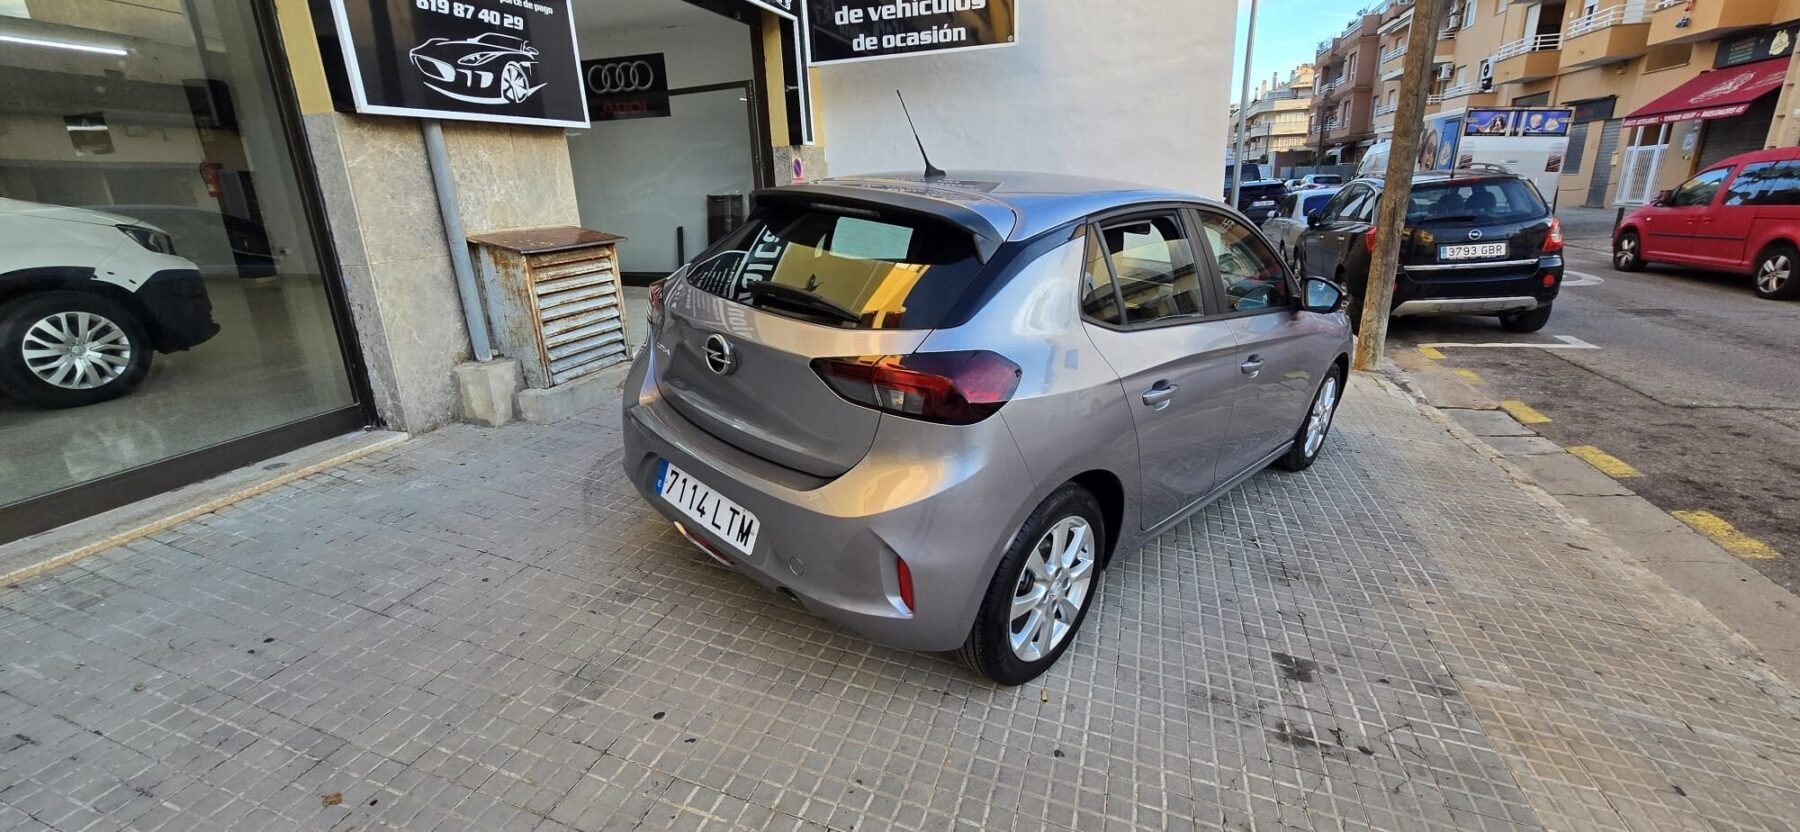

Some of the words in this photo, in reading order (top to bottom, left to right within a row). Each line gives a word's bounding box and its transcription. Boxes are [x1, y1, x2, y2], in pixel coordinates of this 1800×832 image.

[416, 0, 449, 14] 619
[453, 2, 475, 19] 87
[478, 9, 500, 25] 40
[503, 14, 524, 31] 29
[533, 4, 554, 15] pago
[835, 6, 864, 25] de
[852, 34, 878, 51] de
[882, 24, 967, 48] ocasión
[1448, 247, 1477, 257] 3793
[1481, 245, 1503, 255] GBR
[666, 470, 708, 517] 7114
[711, 499, 753, 547] LTM
